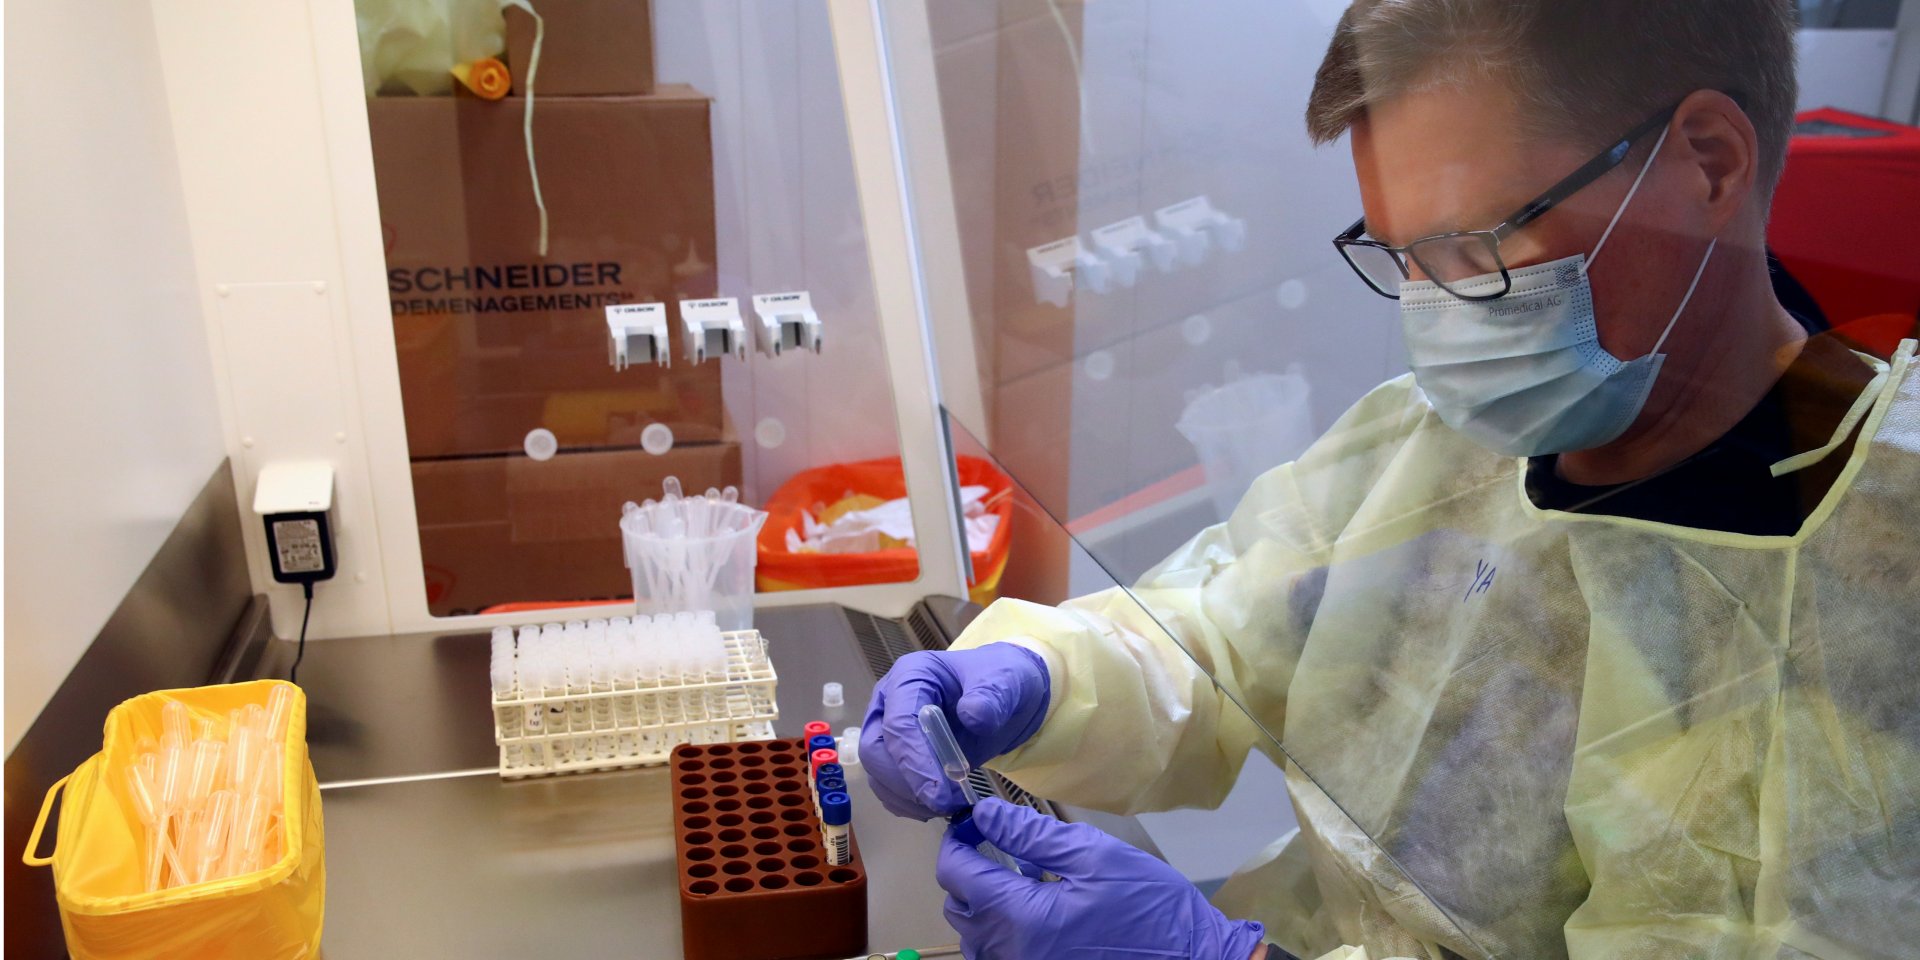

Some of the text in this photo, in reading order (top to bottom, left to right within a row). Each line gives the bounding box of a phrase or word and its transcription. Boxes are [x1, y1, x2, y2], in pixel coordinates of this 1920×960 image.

[388, 262, 622, 293] SCHNEIDER
[1488, 295, 1562, 318] Promedical AG
[1464, 558, 1496, 603] YA
